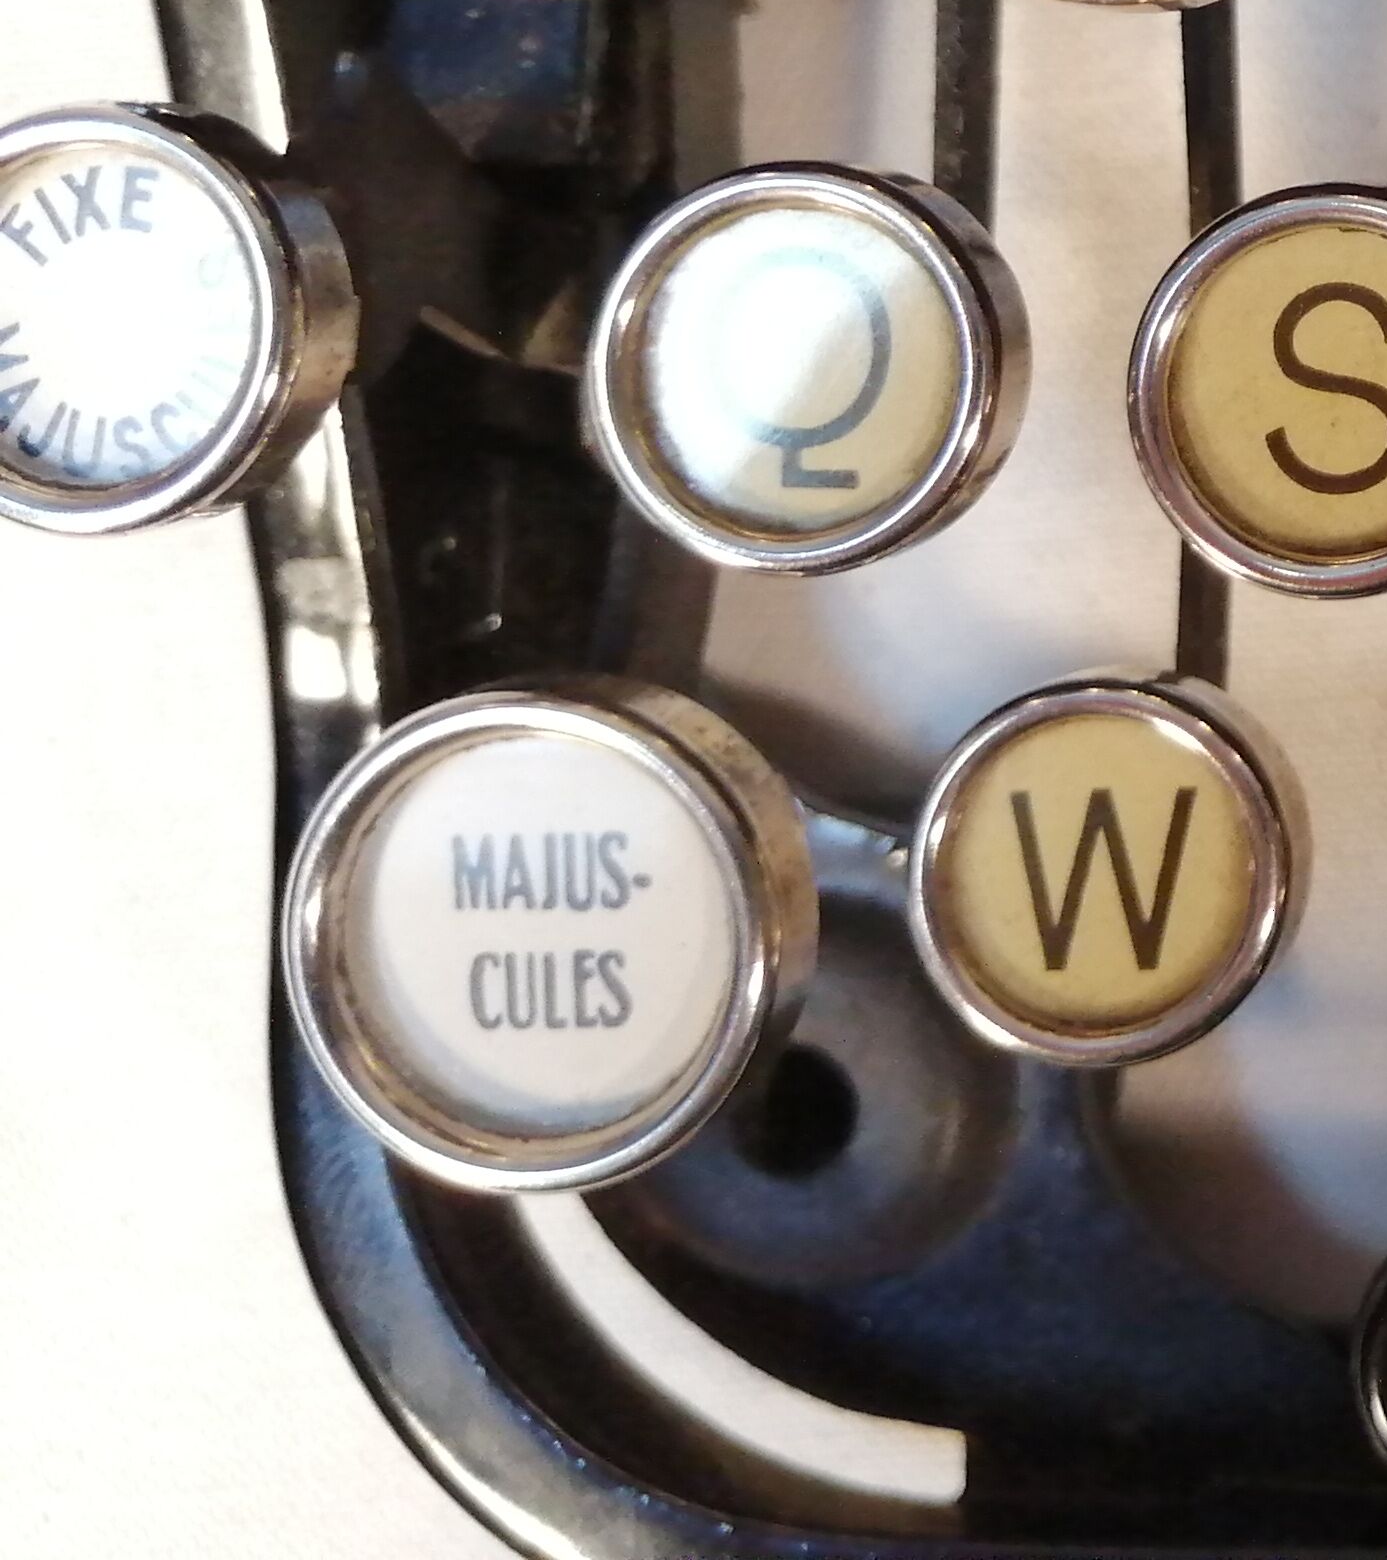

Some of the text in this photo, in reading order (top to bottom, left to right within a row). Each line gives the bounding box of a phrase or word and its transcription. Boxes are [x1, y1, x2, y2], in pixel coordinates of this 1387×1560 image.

[0, 164, 161, 267] FIXE
[710, 246, 892, 490] Q
[451, 832, 651, 914] MAJUS-
[1011, 786, 1197, 972] W
[469, 948, 632, 1030] CULES
